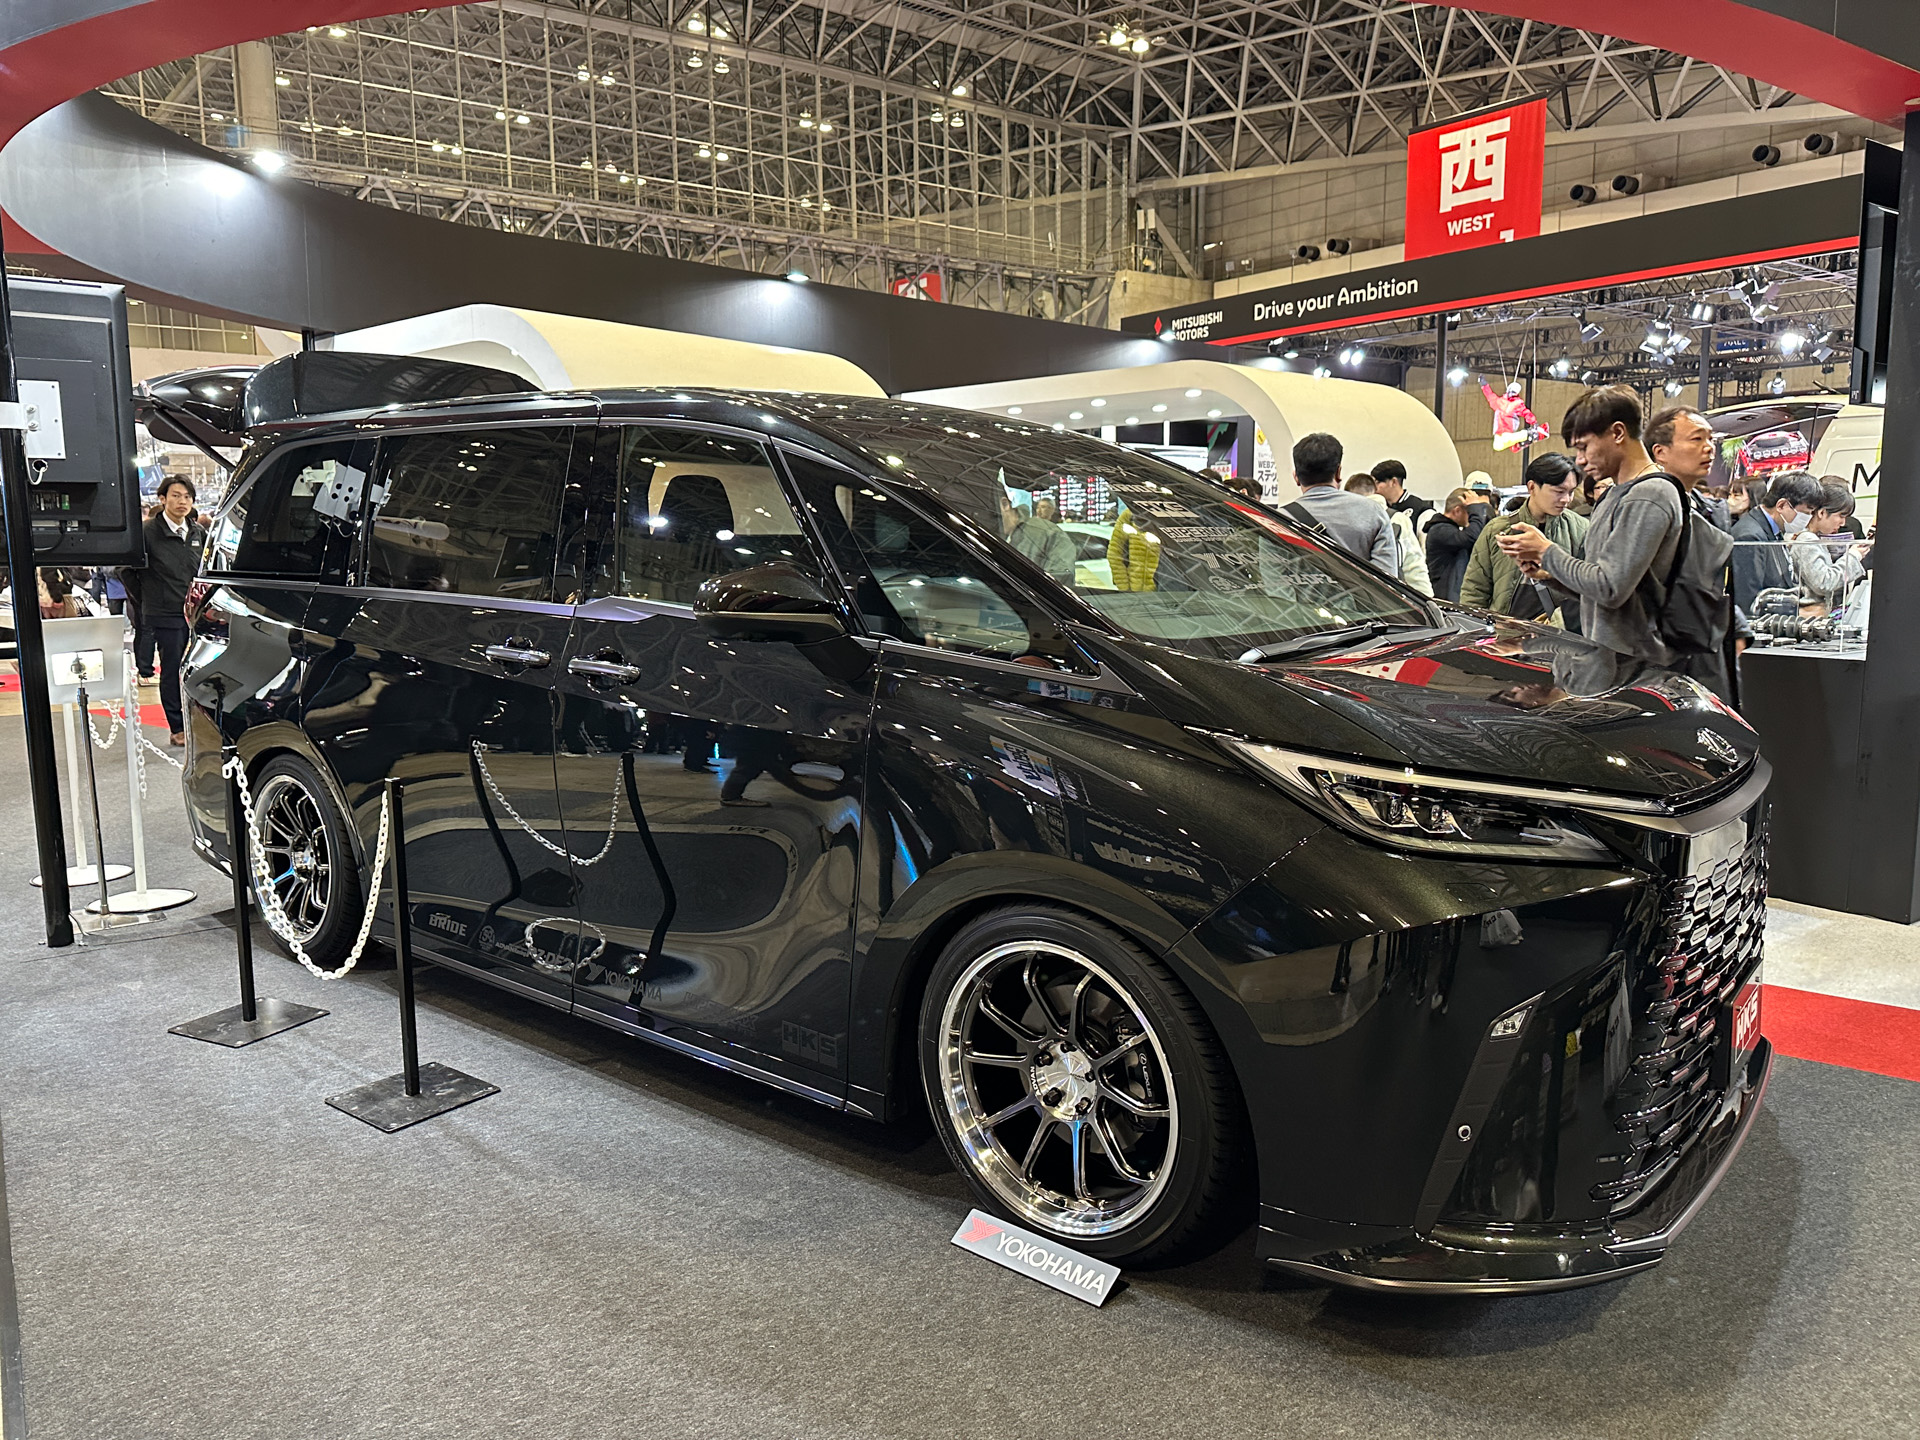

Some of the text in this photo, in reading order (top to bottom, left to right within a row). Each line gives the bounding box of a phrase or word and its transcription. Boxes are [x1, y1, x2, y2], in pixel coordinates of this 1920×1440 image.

[1439, 116, 1511, 213] 西
[1447, 213, 1494, 236] WEST
[1254, 278, 1419, 321] Drive your Ambition
[1171, 311, 1223, 330] MITSUBISHI
[429, 912, 468, 937] BRIDE
[605, 970, 662, 1002] YOKOHAMA
[1735, 988, 1759, 1050] HKS
[783, 1021, 837, 1062] HKS
[1030, 1066, 1042, 1096] ADVAN
[1142, 1066, 1153, 1098] LEXUS
[996, 1232, 1107, 1295] YOKOHAMA
